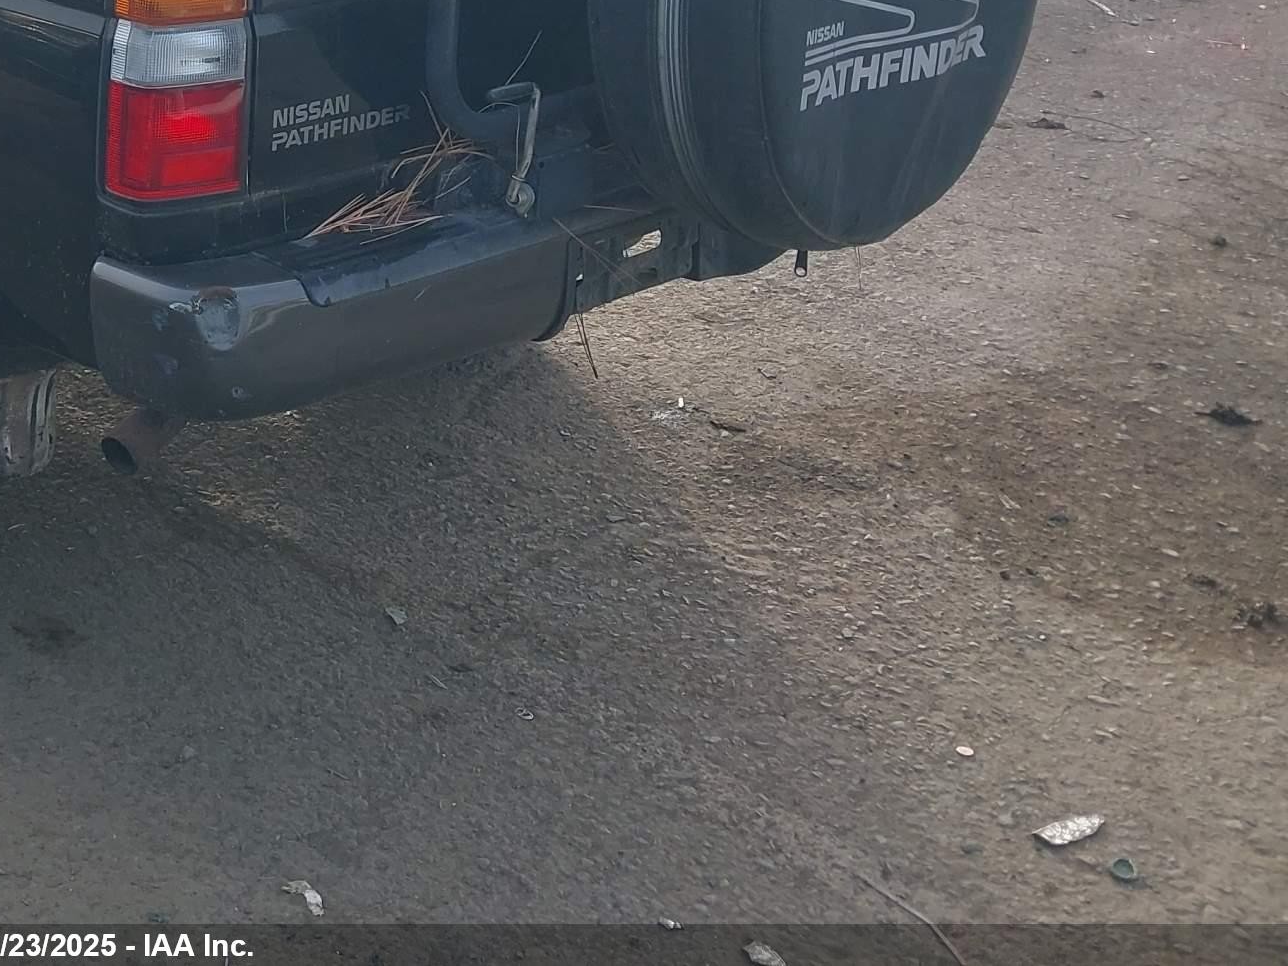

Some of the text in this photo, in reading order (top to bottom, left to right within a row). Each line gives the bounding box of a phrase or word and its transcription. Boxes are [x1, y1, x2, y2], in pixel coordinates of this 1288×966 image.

[806, 21, 845, 46] NISSAN
[800, 25, 986, 111] PATHFINDER
[271, 104, 411, 152] PATHFINDER
[272, 94, 350, 129] NISSAN
